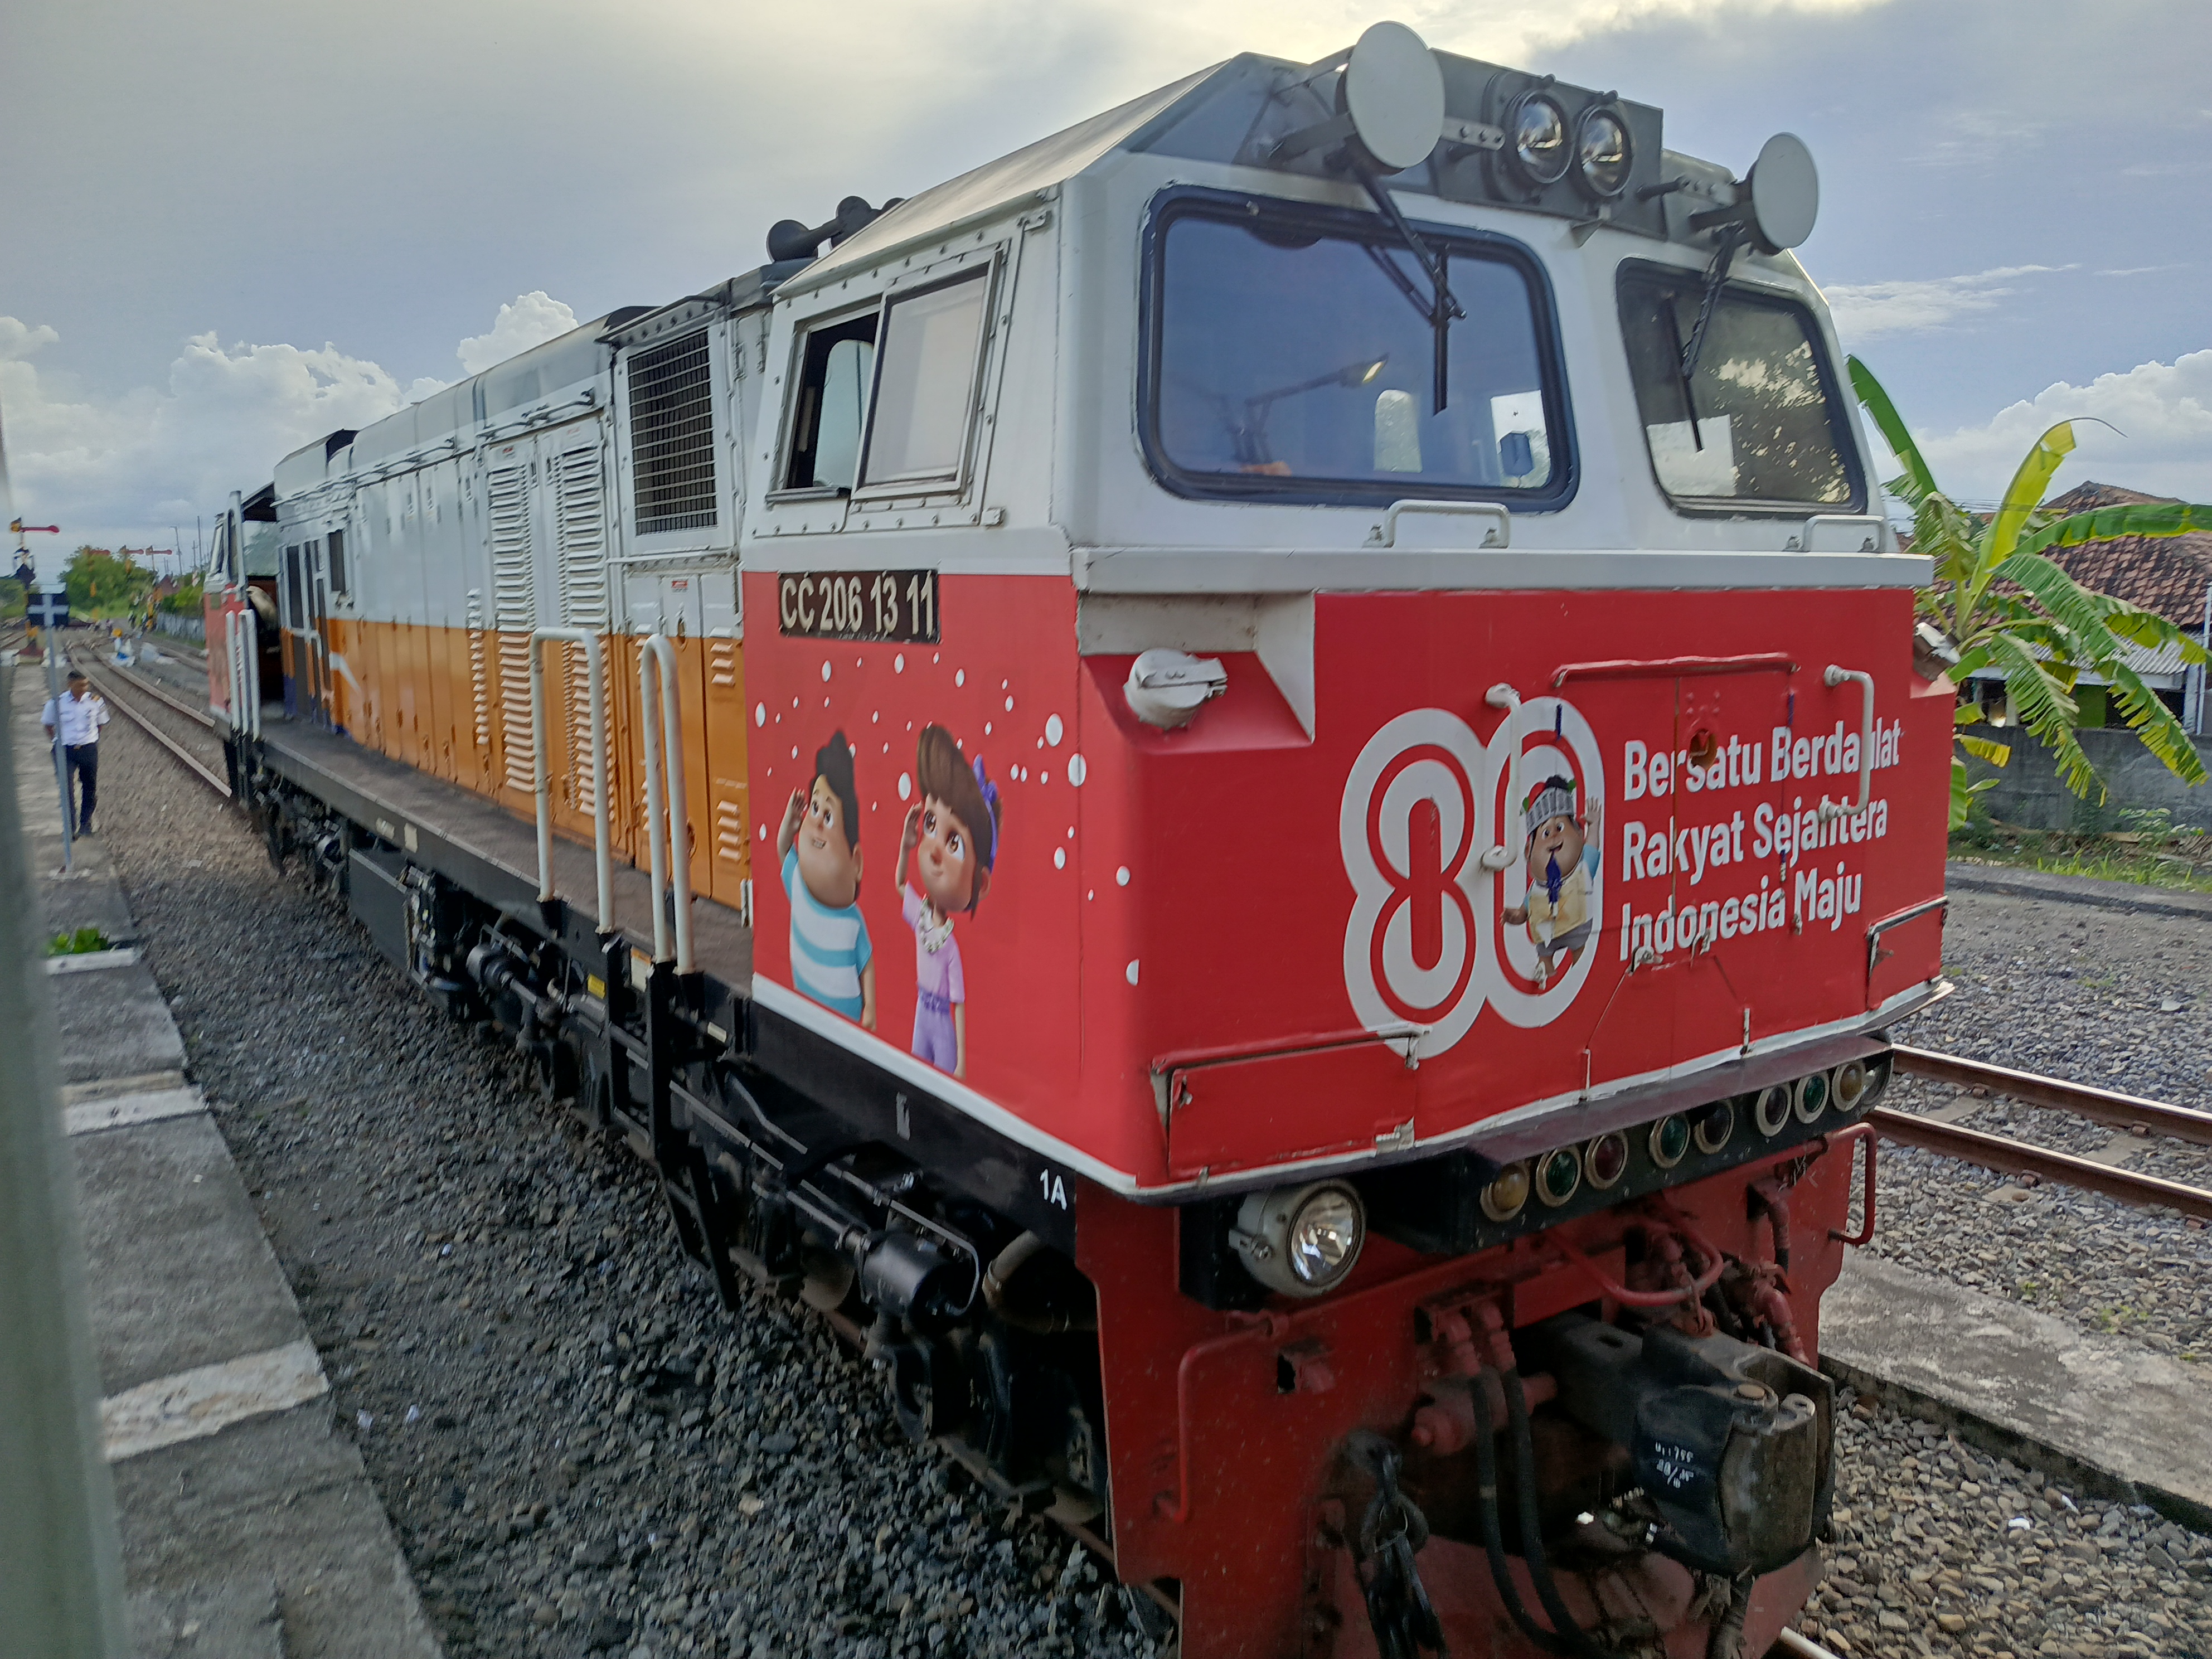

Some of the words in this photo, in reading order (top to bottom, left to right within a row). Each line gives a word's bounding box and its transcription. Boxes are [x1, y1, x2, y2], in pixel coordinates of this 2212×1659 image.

[782, 578, 814, 630] CC
[819, 576, 863, 632] 206
[870, 575, 898, 633] 13
[906, 574, 933, 636] 11
[1624, 734, 1762, 801] Bersatu
[1340, 696, 1605, 1059] 80
[1622, 811, 1745, 885] Rakyat
[1619, 875, 1786, 962] Indonesia
[1794, 861, 1862, 932] Maju
[1040, 1168, 1067, 1211] 1A
